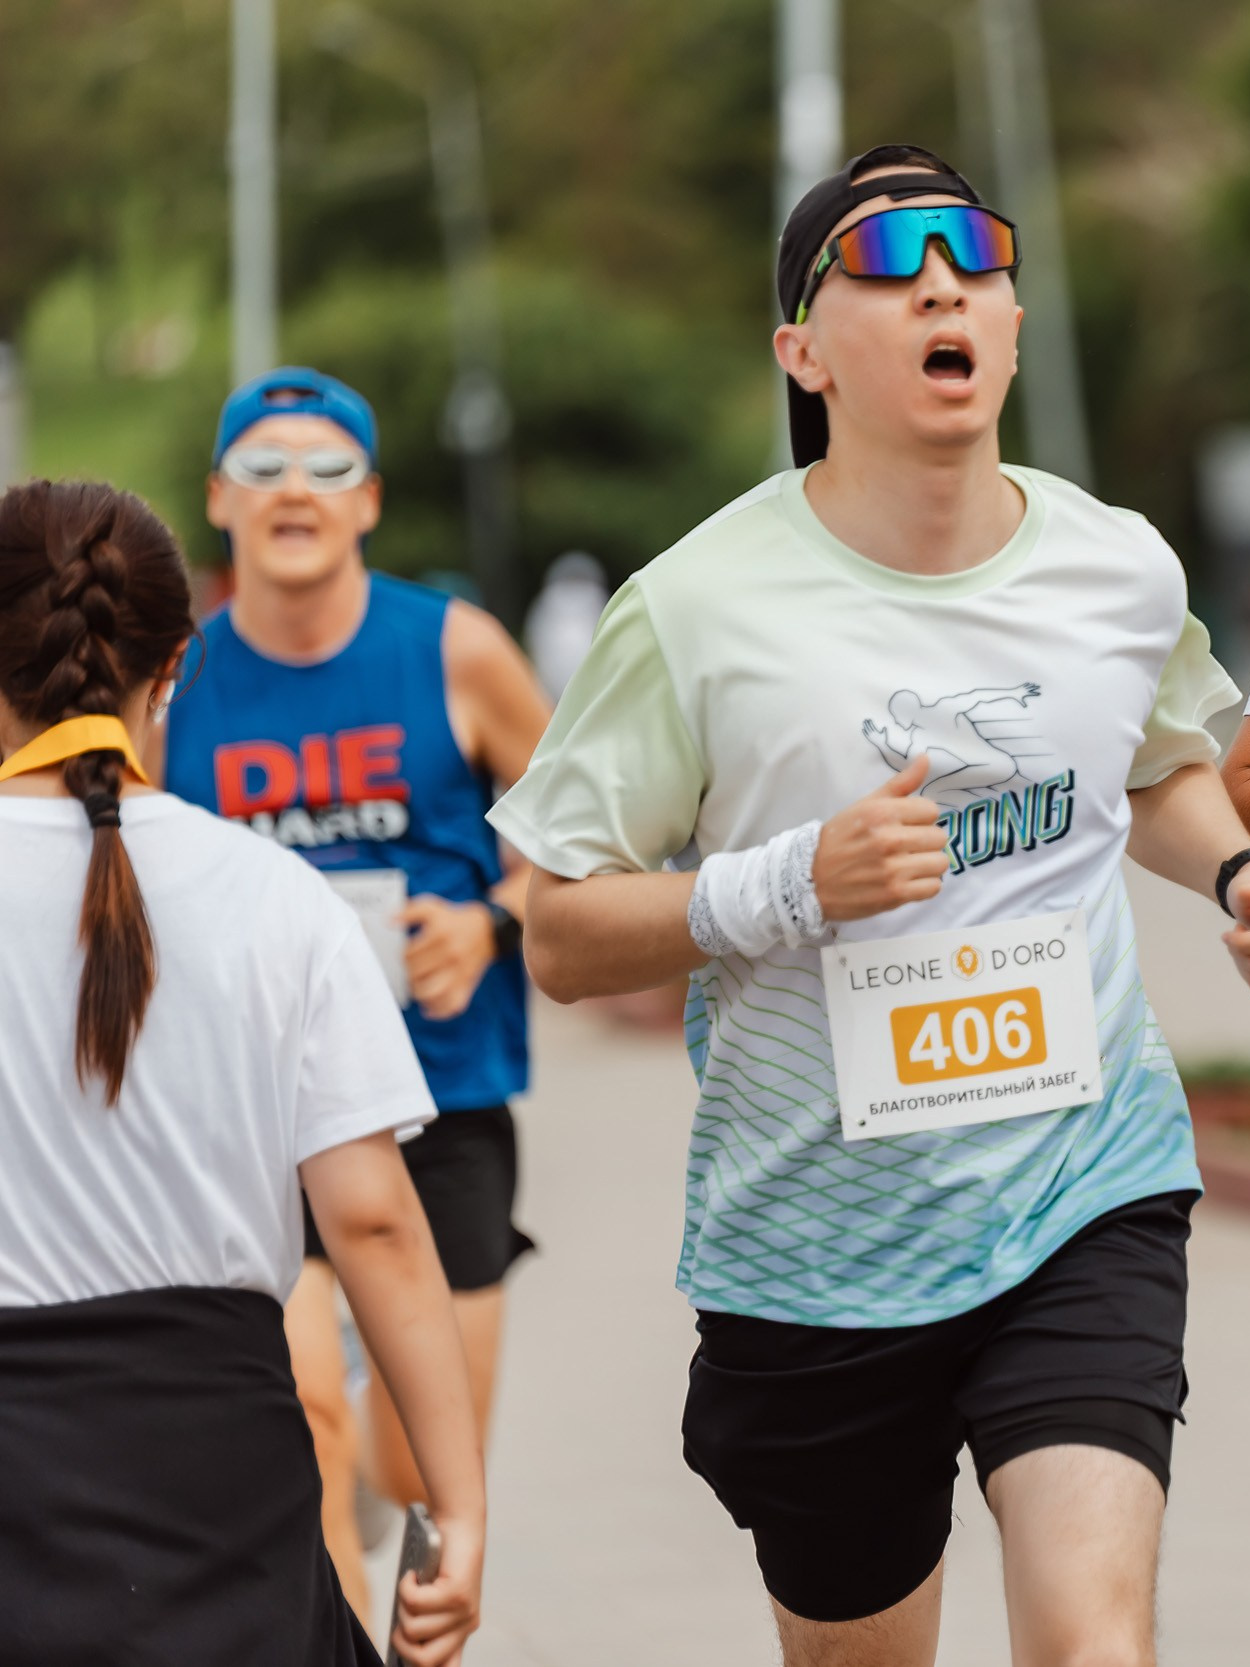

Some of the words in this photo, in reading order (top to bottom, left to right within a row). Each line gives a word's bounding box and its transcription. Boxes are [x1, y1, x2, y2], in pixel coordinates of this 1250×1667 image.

[213, 722, 411, 820] DIE
[849, 959, 943, 991] LEONE
[992, 939, 1066, 971] D'ORO
[908, 999, 1032, 1071] 406
[869, 1076, 1036, 1116] БЛАГОТВОРИТЕЛЬНЫЙ
[1038, 1071, 1078, 1090] ЗАБЕГ
